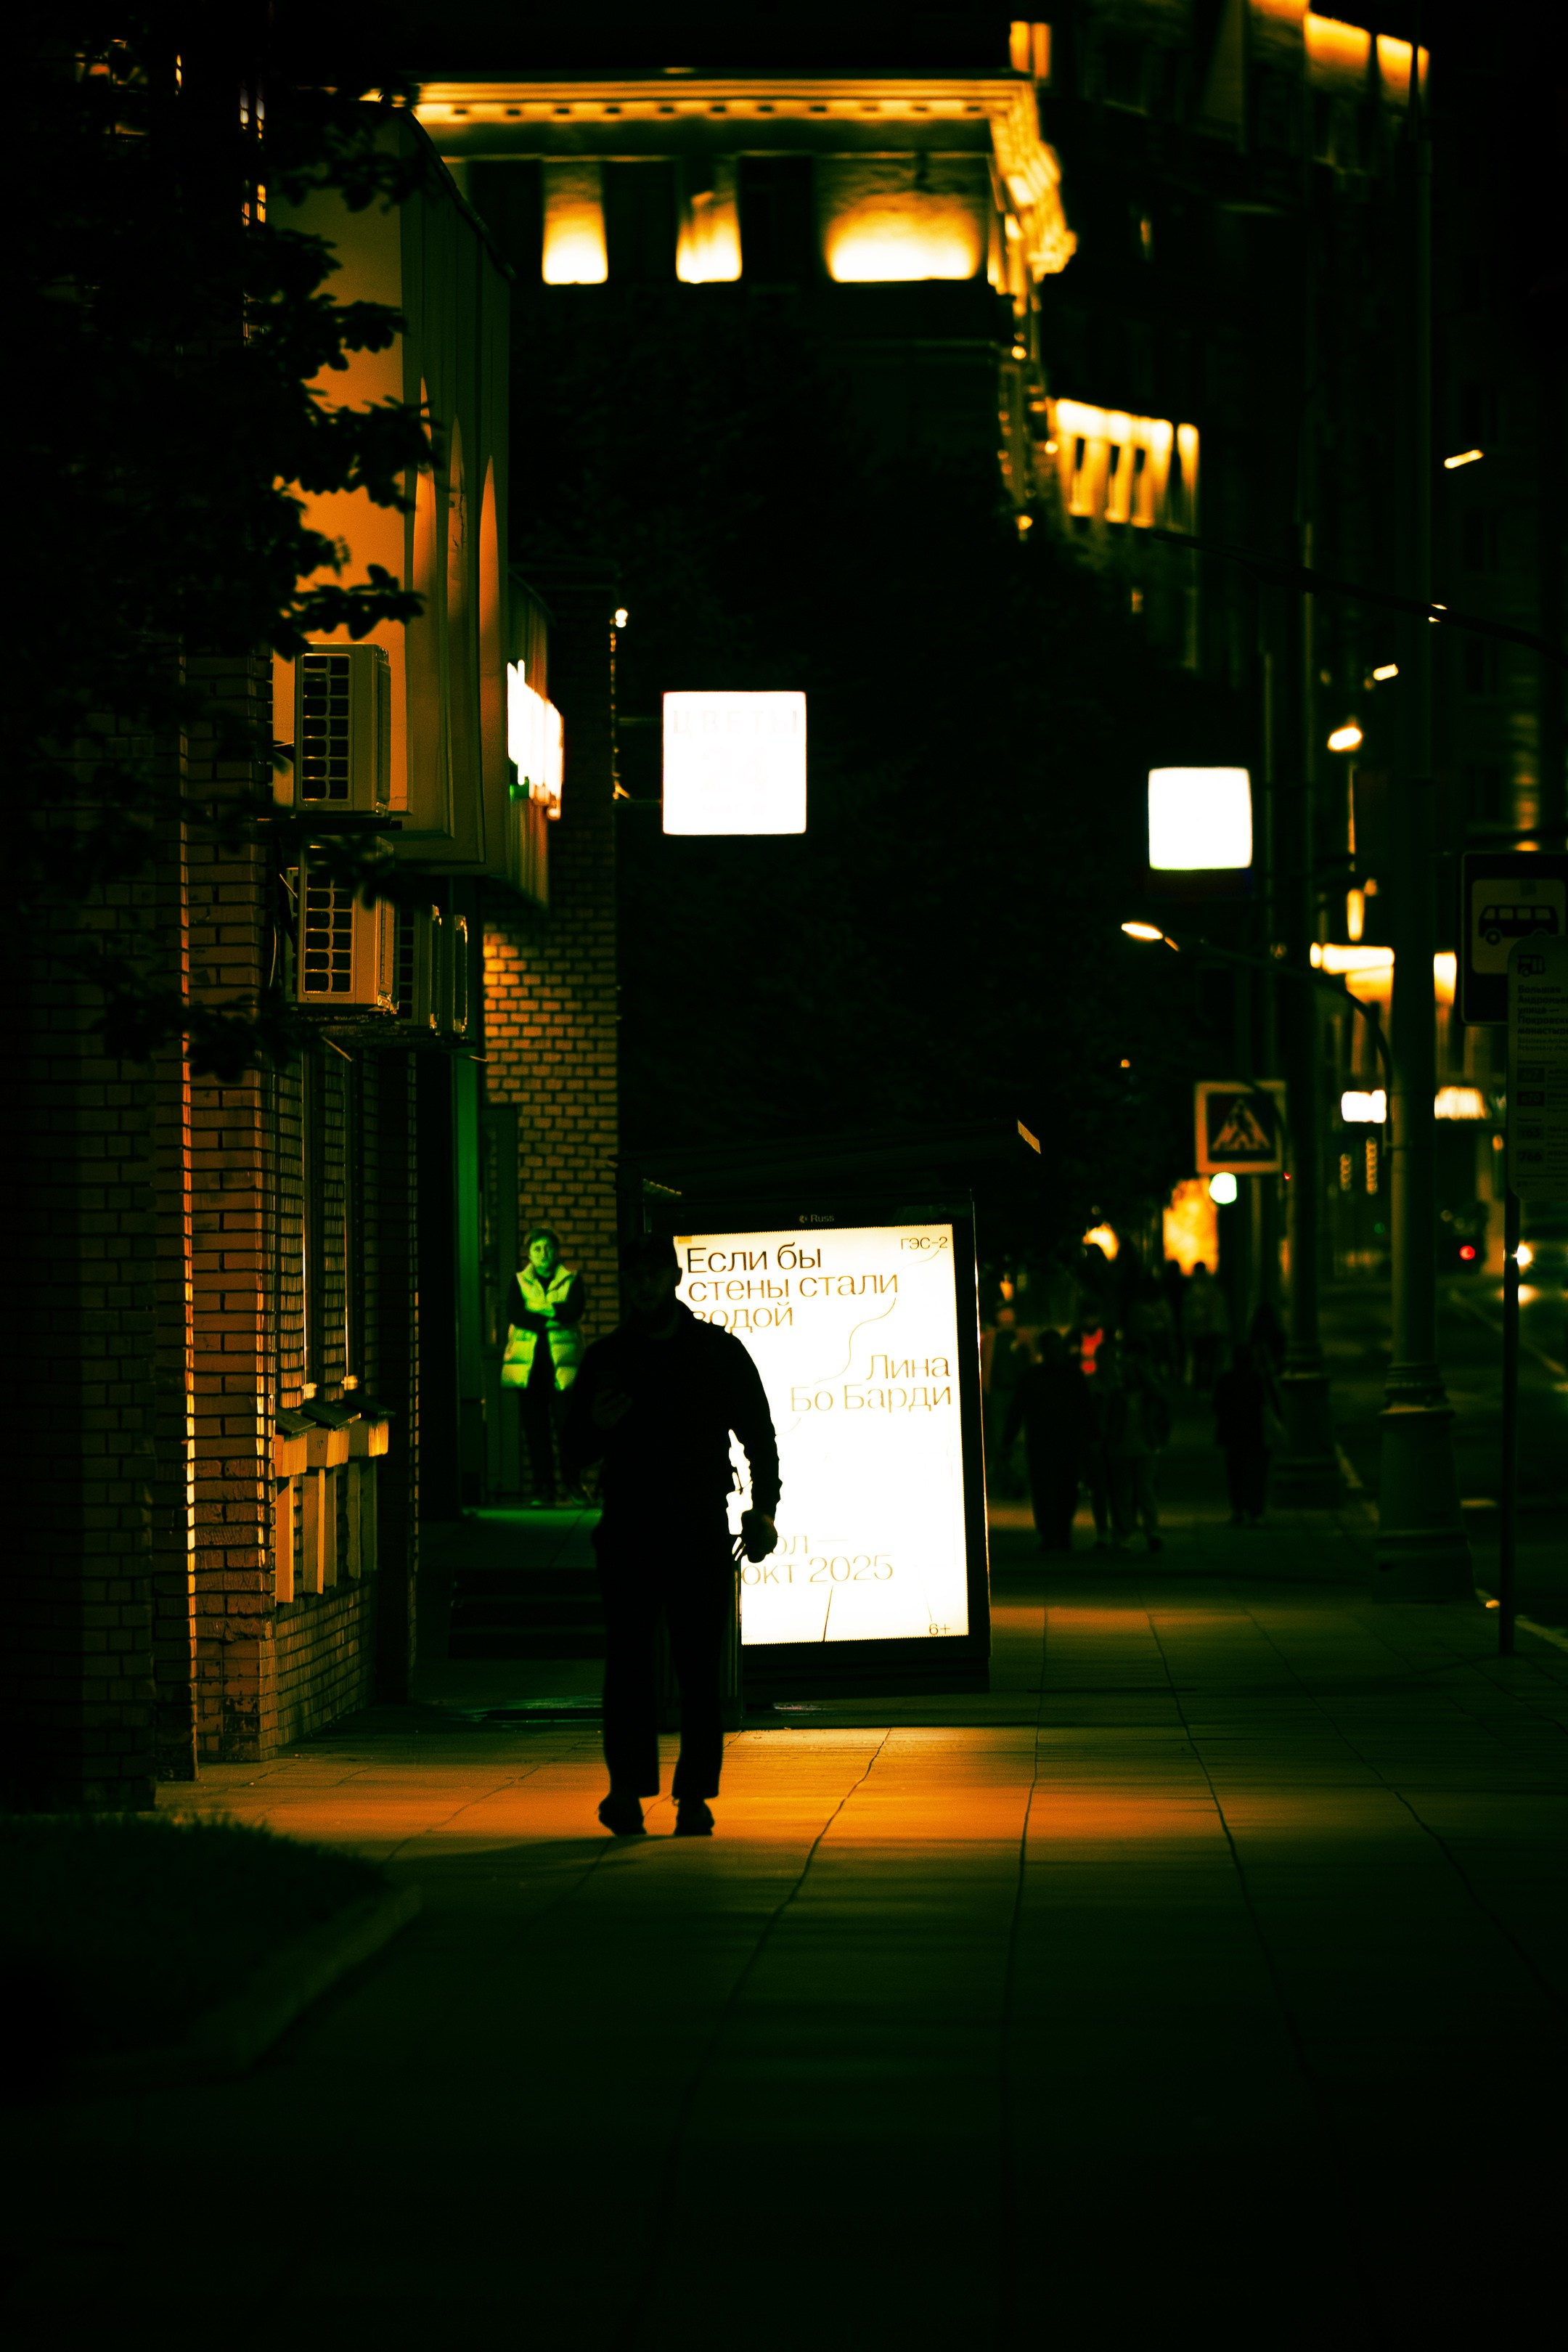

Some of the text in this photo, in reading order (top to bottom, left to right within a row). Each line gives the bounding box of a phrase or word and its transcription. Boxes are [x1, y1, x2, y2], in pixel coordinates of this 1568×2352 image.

[810, 1214, 835, 1223] Russ
[901, 1236, 948, 1250] ГЭС-2
[687, 1241, 821, 1274] Если бы
[688, 1273, 899, 1302] стены стали
[866, 1355, 951, 1380] Лина
[791, 1383, 952, 1414] Бо Барди
[741, 1553, 894, 1585] окт 2025
[928, 1622, 952, 1636] 6+
